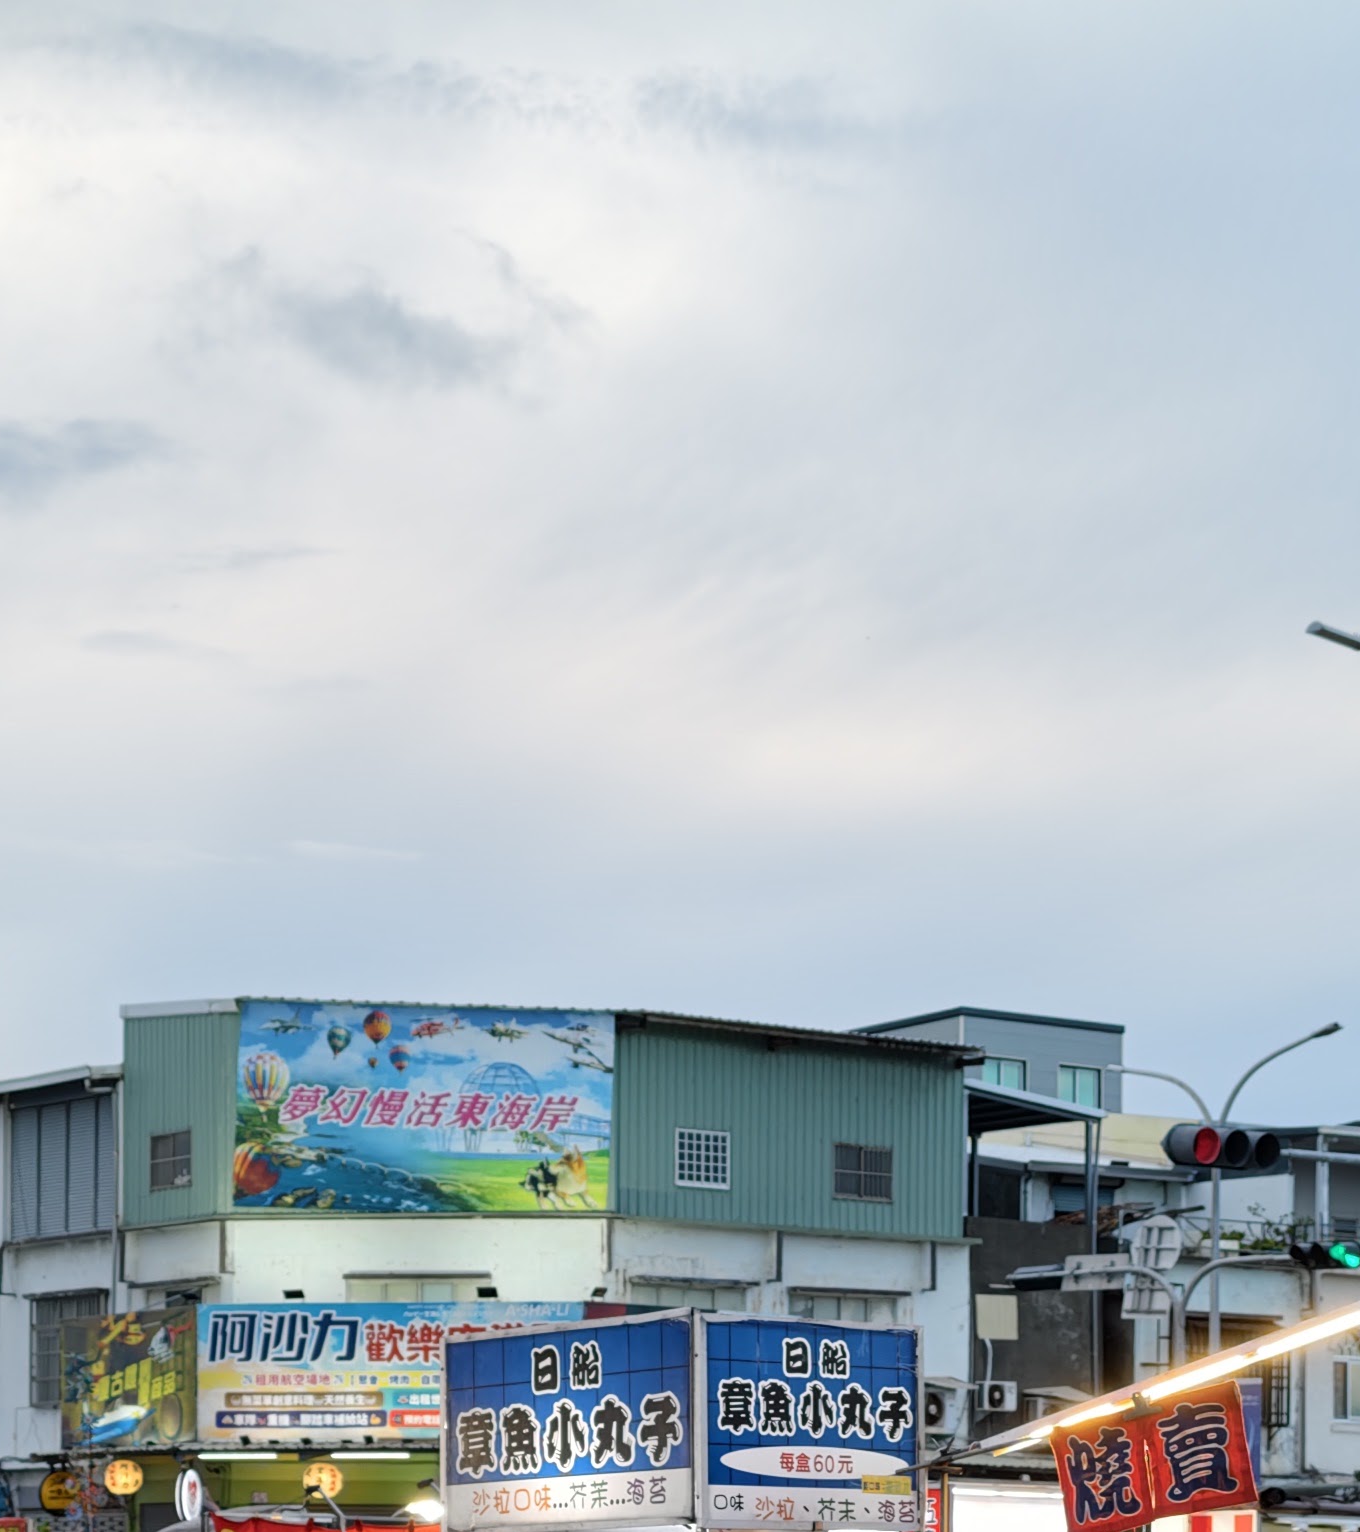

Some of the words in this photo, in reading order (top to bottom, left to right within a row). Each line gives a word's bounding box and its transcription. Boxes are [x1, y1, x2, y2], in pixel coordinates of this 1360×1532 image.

[279, 1084, 579, 1134] 夢幻慢活東海岸
[208, 1311, 361, 1363] 阿沙力
[782, 1337, 851, 1380] 日船
[529, 1339, 603, 1396] 日船
[456, 1391, 682, 1480] 章魚小丸子
[717, 1378, 913, 1443] 章魚小丸子
[778, 1452, 854, 1475] 每盒60元
[1065, 1403, 1240, 1526] 燒賣
[713, 1493, 745, 1513] 口味
